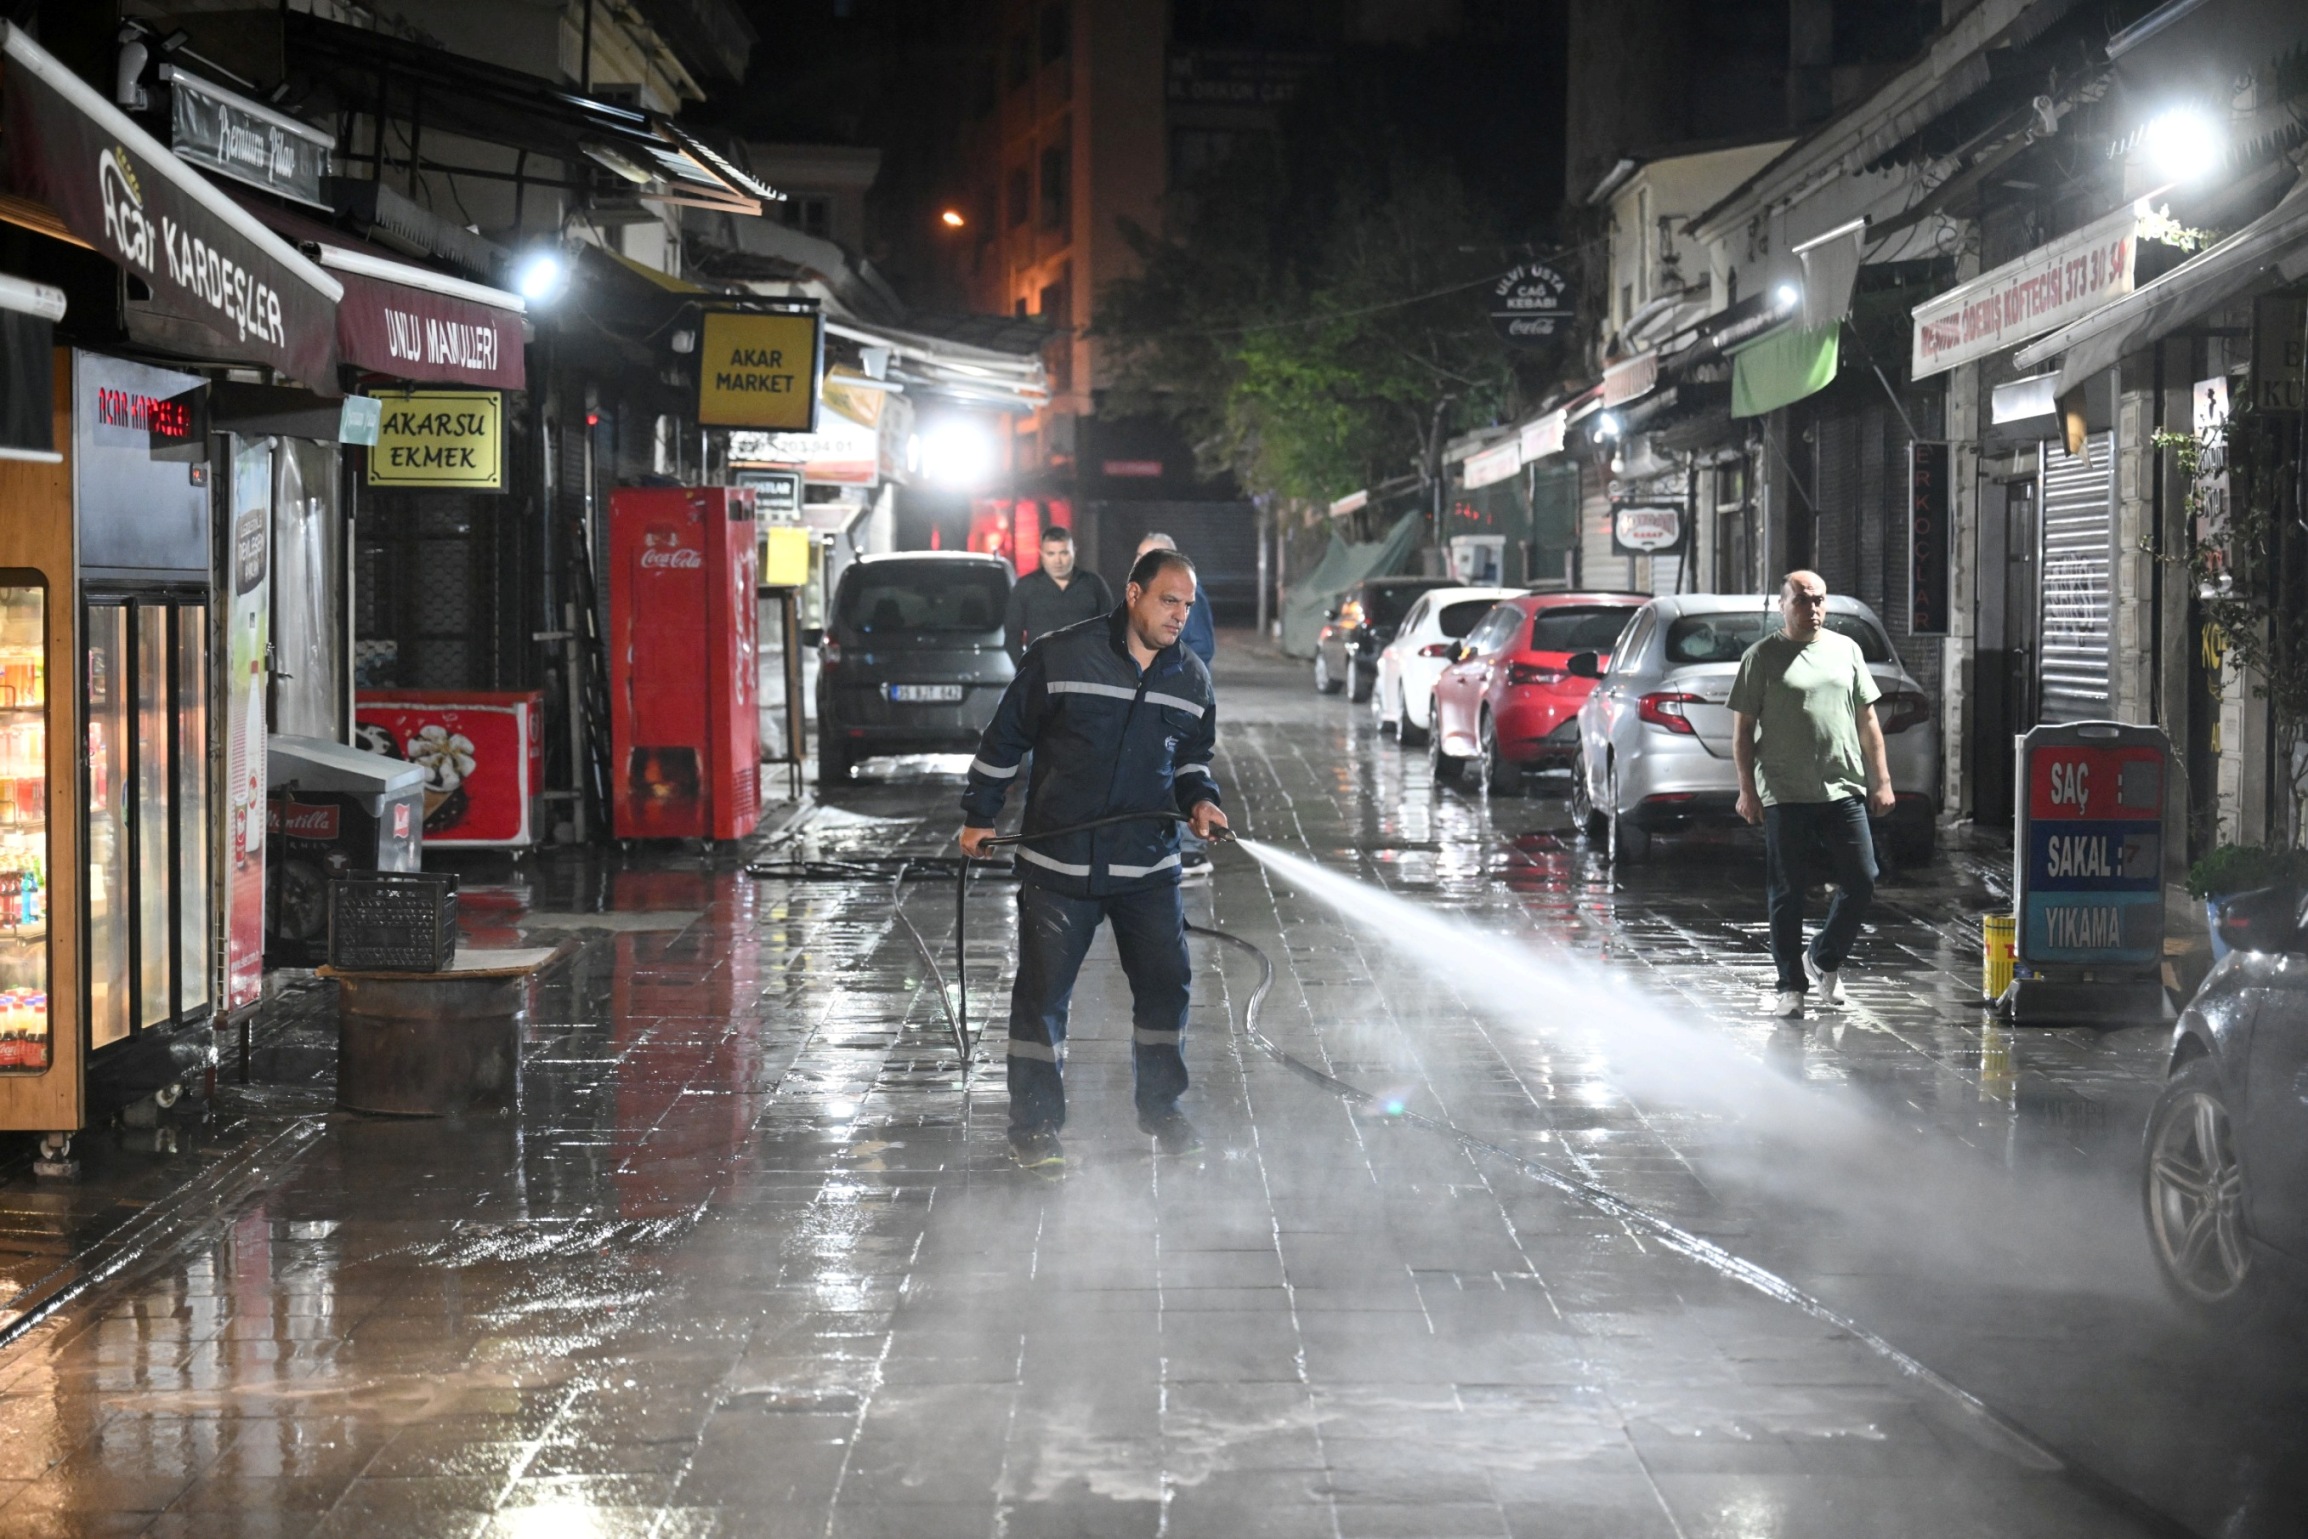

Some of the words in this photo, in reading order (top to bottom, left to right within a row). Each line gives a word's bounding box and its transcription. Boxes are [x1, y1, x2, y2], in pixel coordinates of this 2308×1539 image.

[218, 104, 264, 167] Premium
[100, 148, 155, 274] Acar
[162, 215, 285, 349] KARDEŞLER
[2004, 256, 2064, 327] KÖFTECİSİ
[2065, 255, 2088, 302] 373
[384, 307, 421, 362] UNLU
[426, 318, 498, 371] MAMULLERİ
[731, 348, 783, 368] AKAR
[716, 372, 794, 393] MARKET
[383, 412, 485, 437] AKARSU
[391, 445, 477, 468] EKMEK
[1915, 446, 1931, 628] ERKOÇLAR
[641, 549, 701, 568] Coca-Cola
[2052, 762, 2089, 815] SAÇ
[2048, 835, 2111, 877] SAKAL
[2045, 907, 2120, 947] YIKAMA
